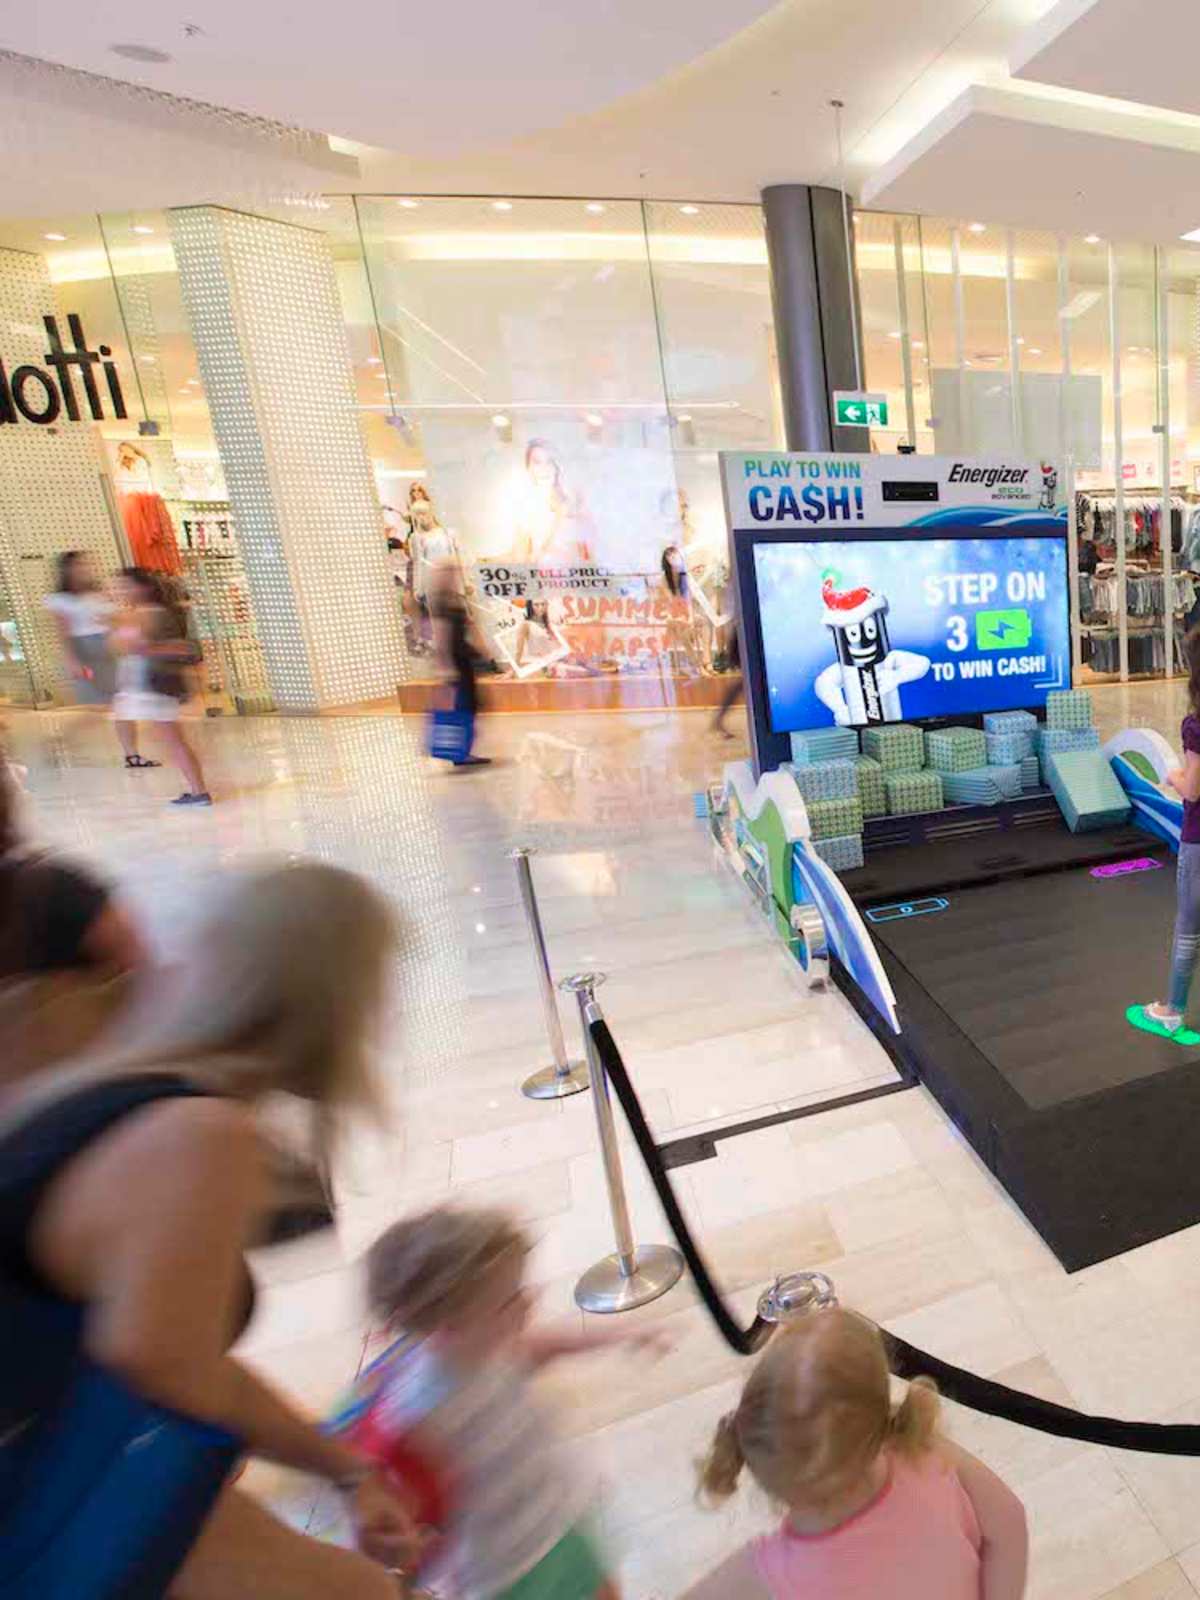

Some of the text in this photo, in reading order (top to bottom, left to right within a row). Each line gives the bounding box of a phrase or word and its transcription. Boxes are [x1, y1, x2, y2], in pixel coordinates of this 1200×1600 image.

[744, 461, 862, 479] PLAY TO WIN
[948, 463, 1029, 488] Energizer
[748, 483, 865, 524] CA$H!
[484, 583, 527, 598] OFF
[923, 570, 1046, 607] STEP ON
[945, 615, 969, 653] 3
[931, 655, 1047, 682] TO WIN CASH!
